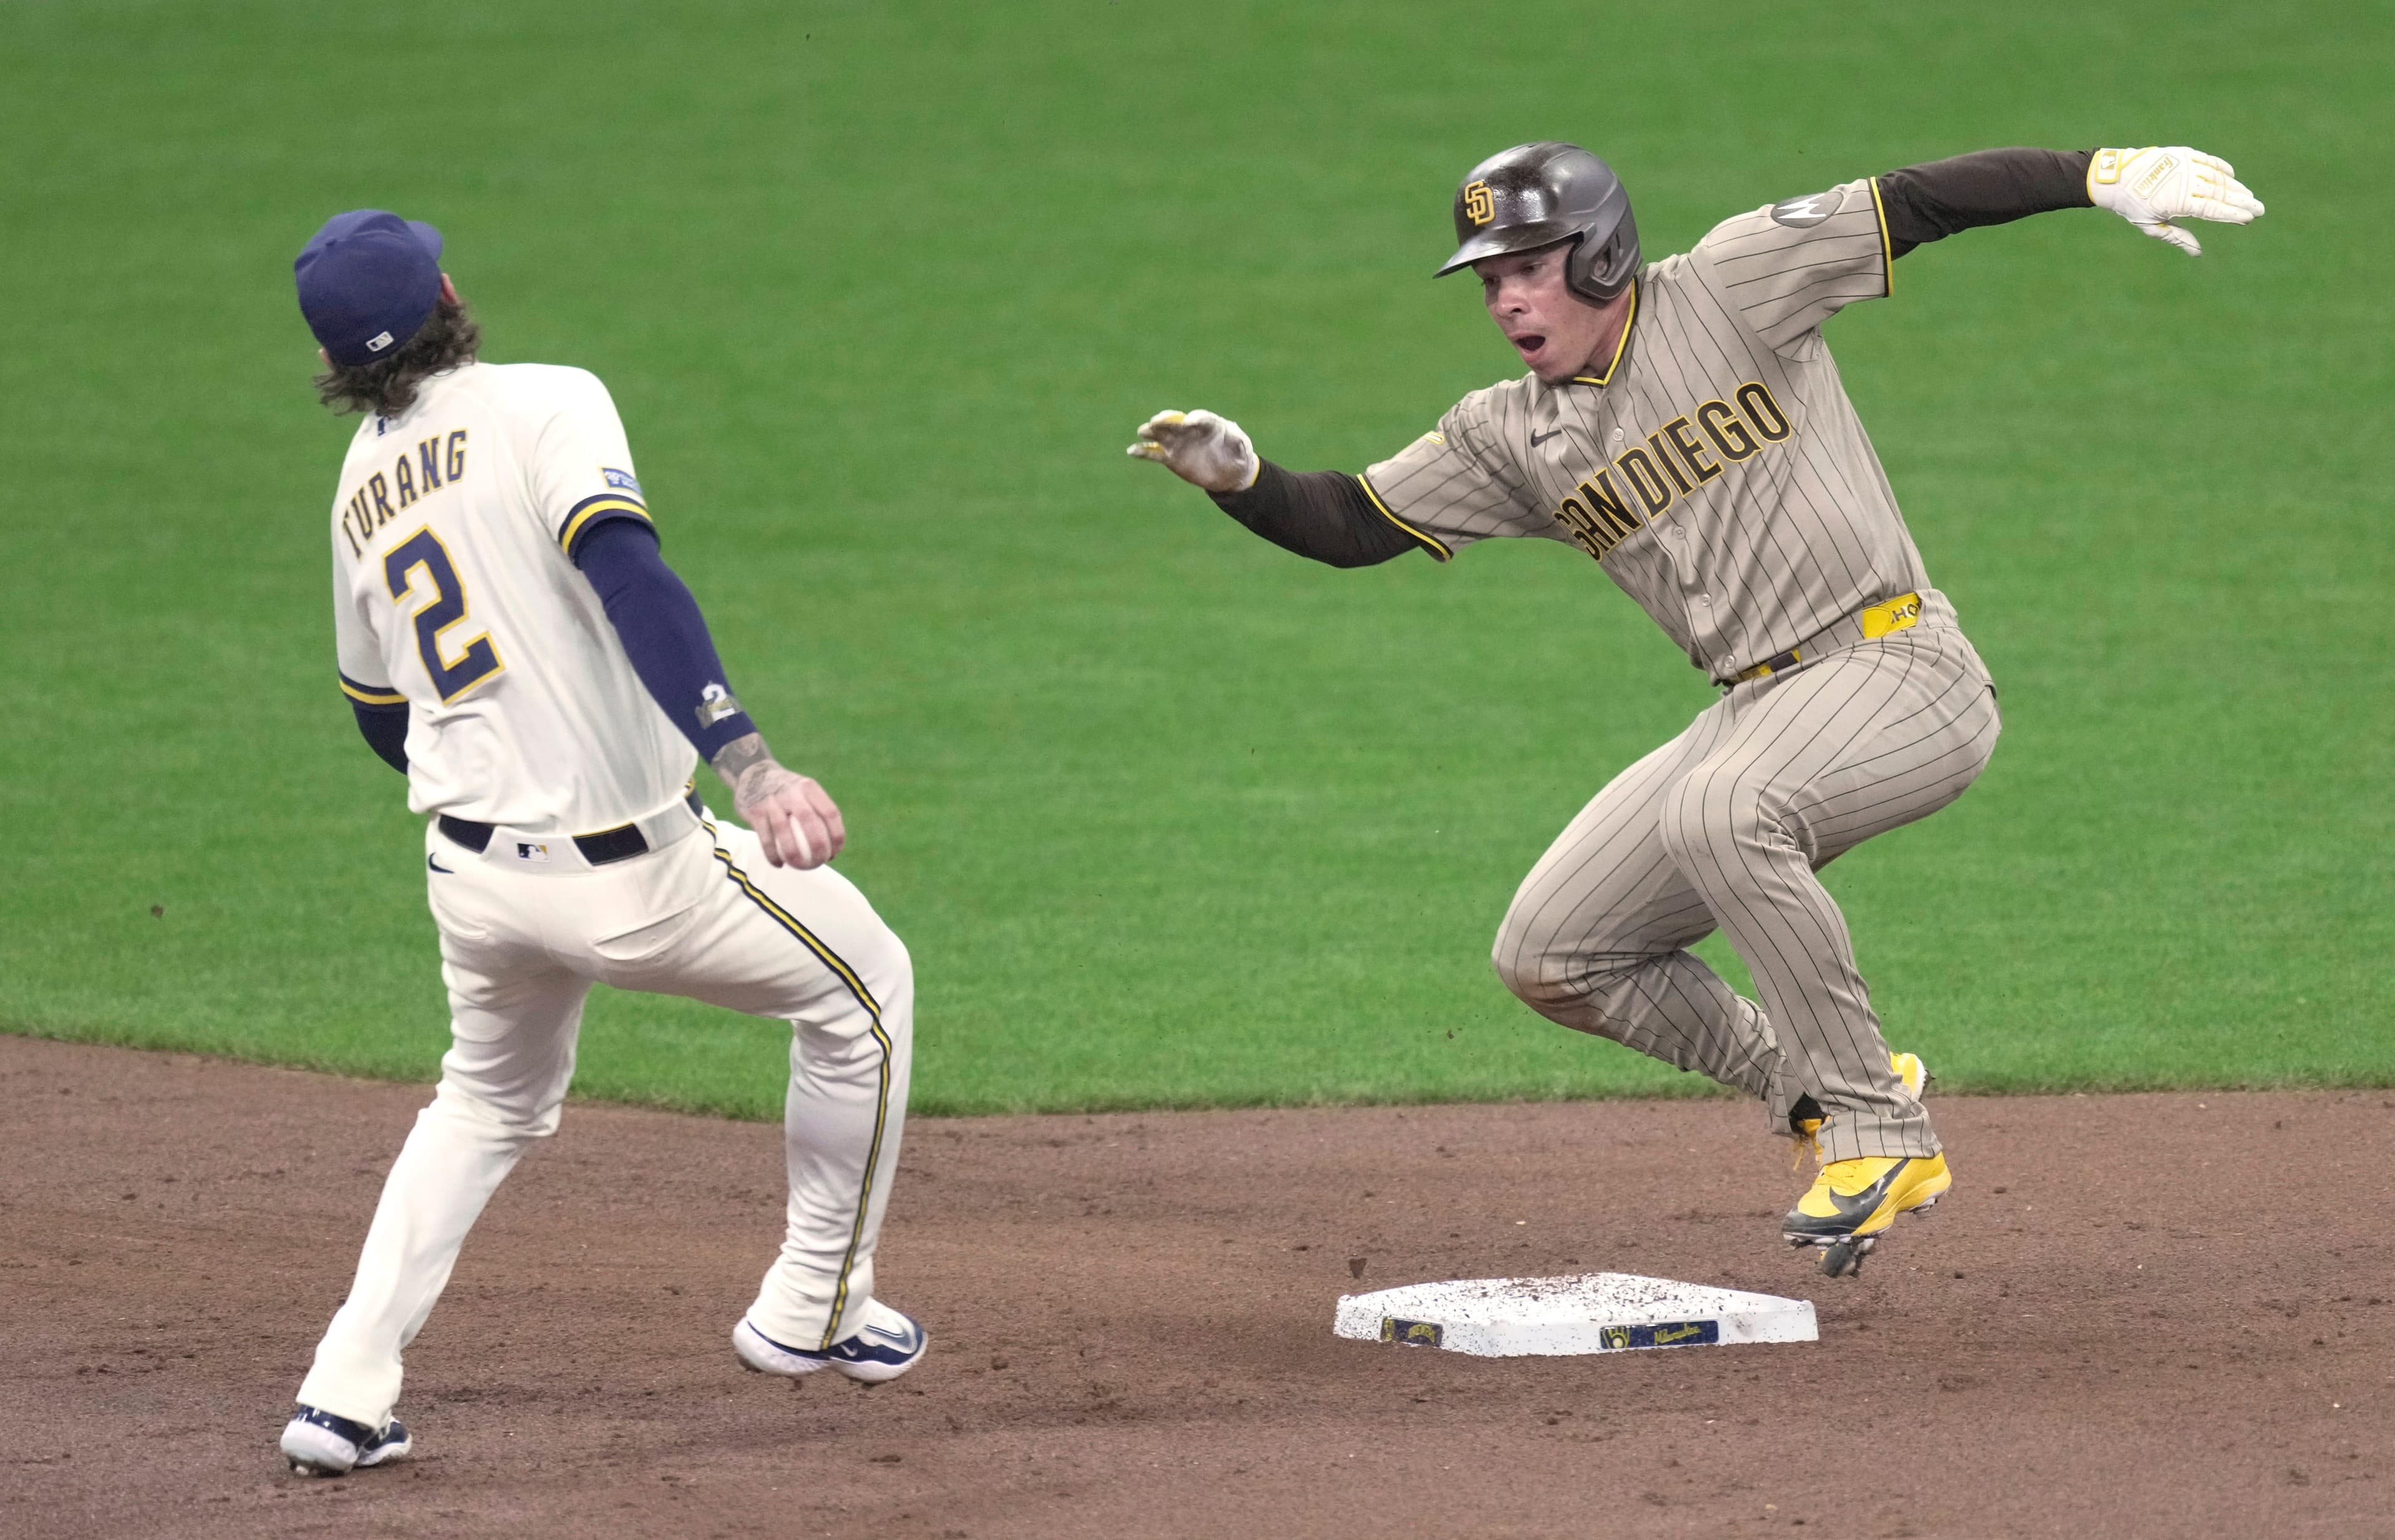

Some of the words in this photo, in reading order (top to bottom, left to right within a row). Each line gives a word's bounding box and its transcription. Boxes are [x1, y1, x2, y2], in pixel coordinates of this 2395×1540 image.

[1464, 180, 1495, 226] SD
[342, 427, 468, 563] TURANG
[1552, 467, 1645, 562] SAN
[1613, 381, 1791, 520] DIEGO
[381, 523, 506, 707] 2
[701, 683, 736, 722] 2
